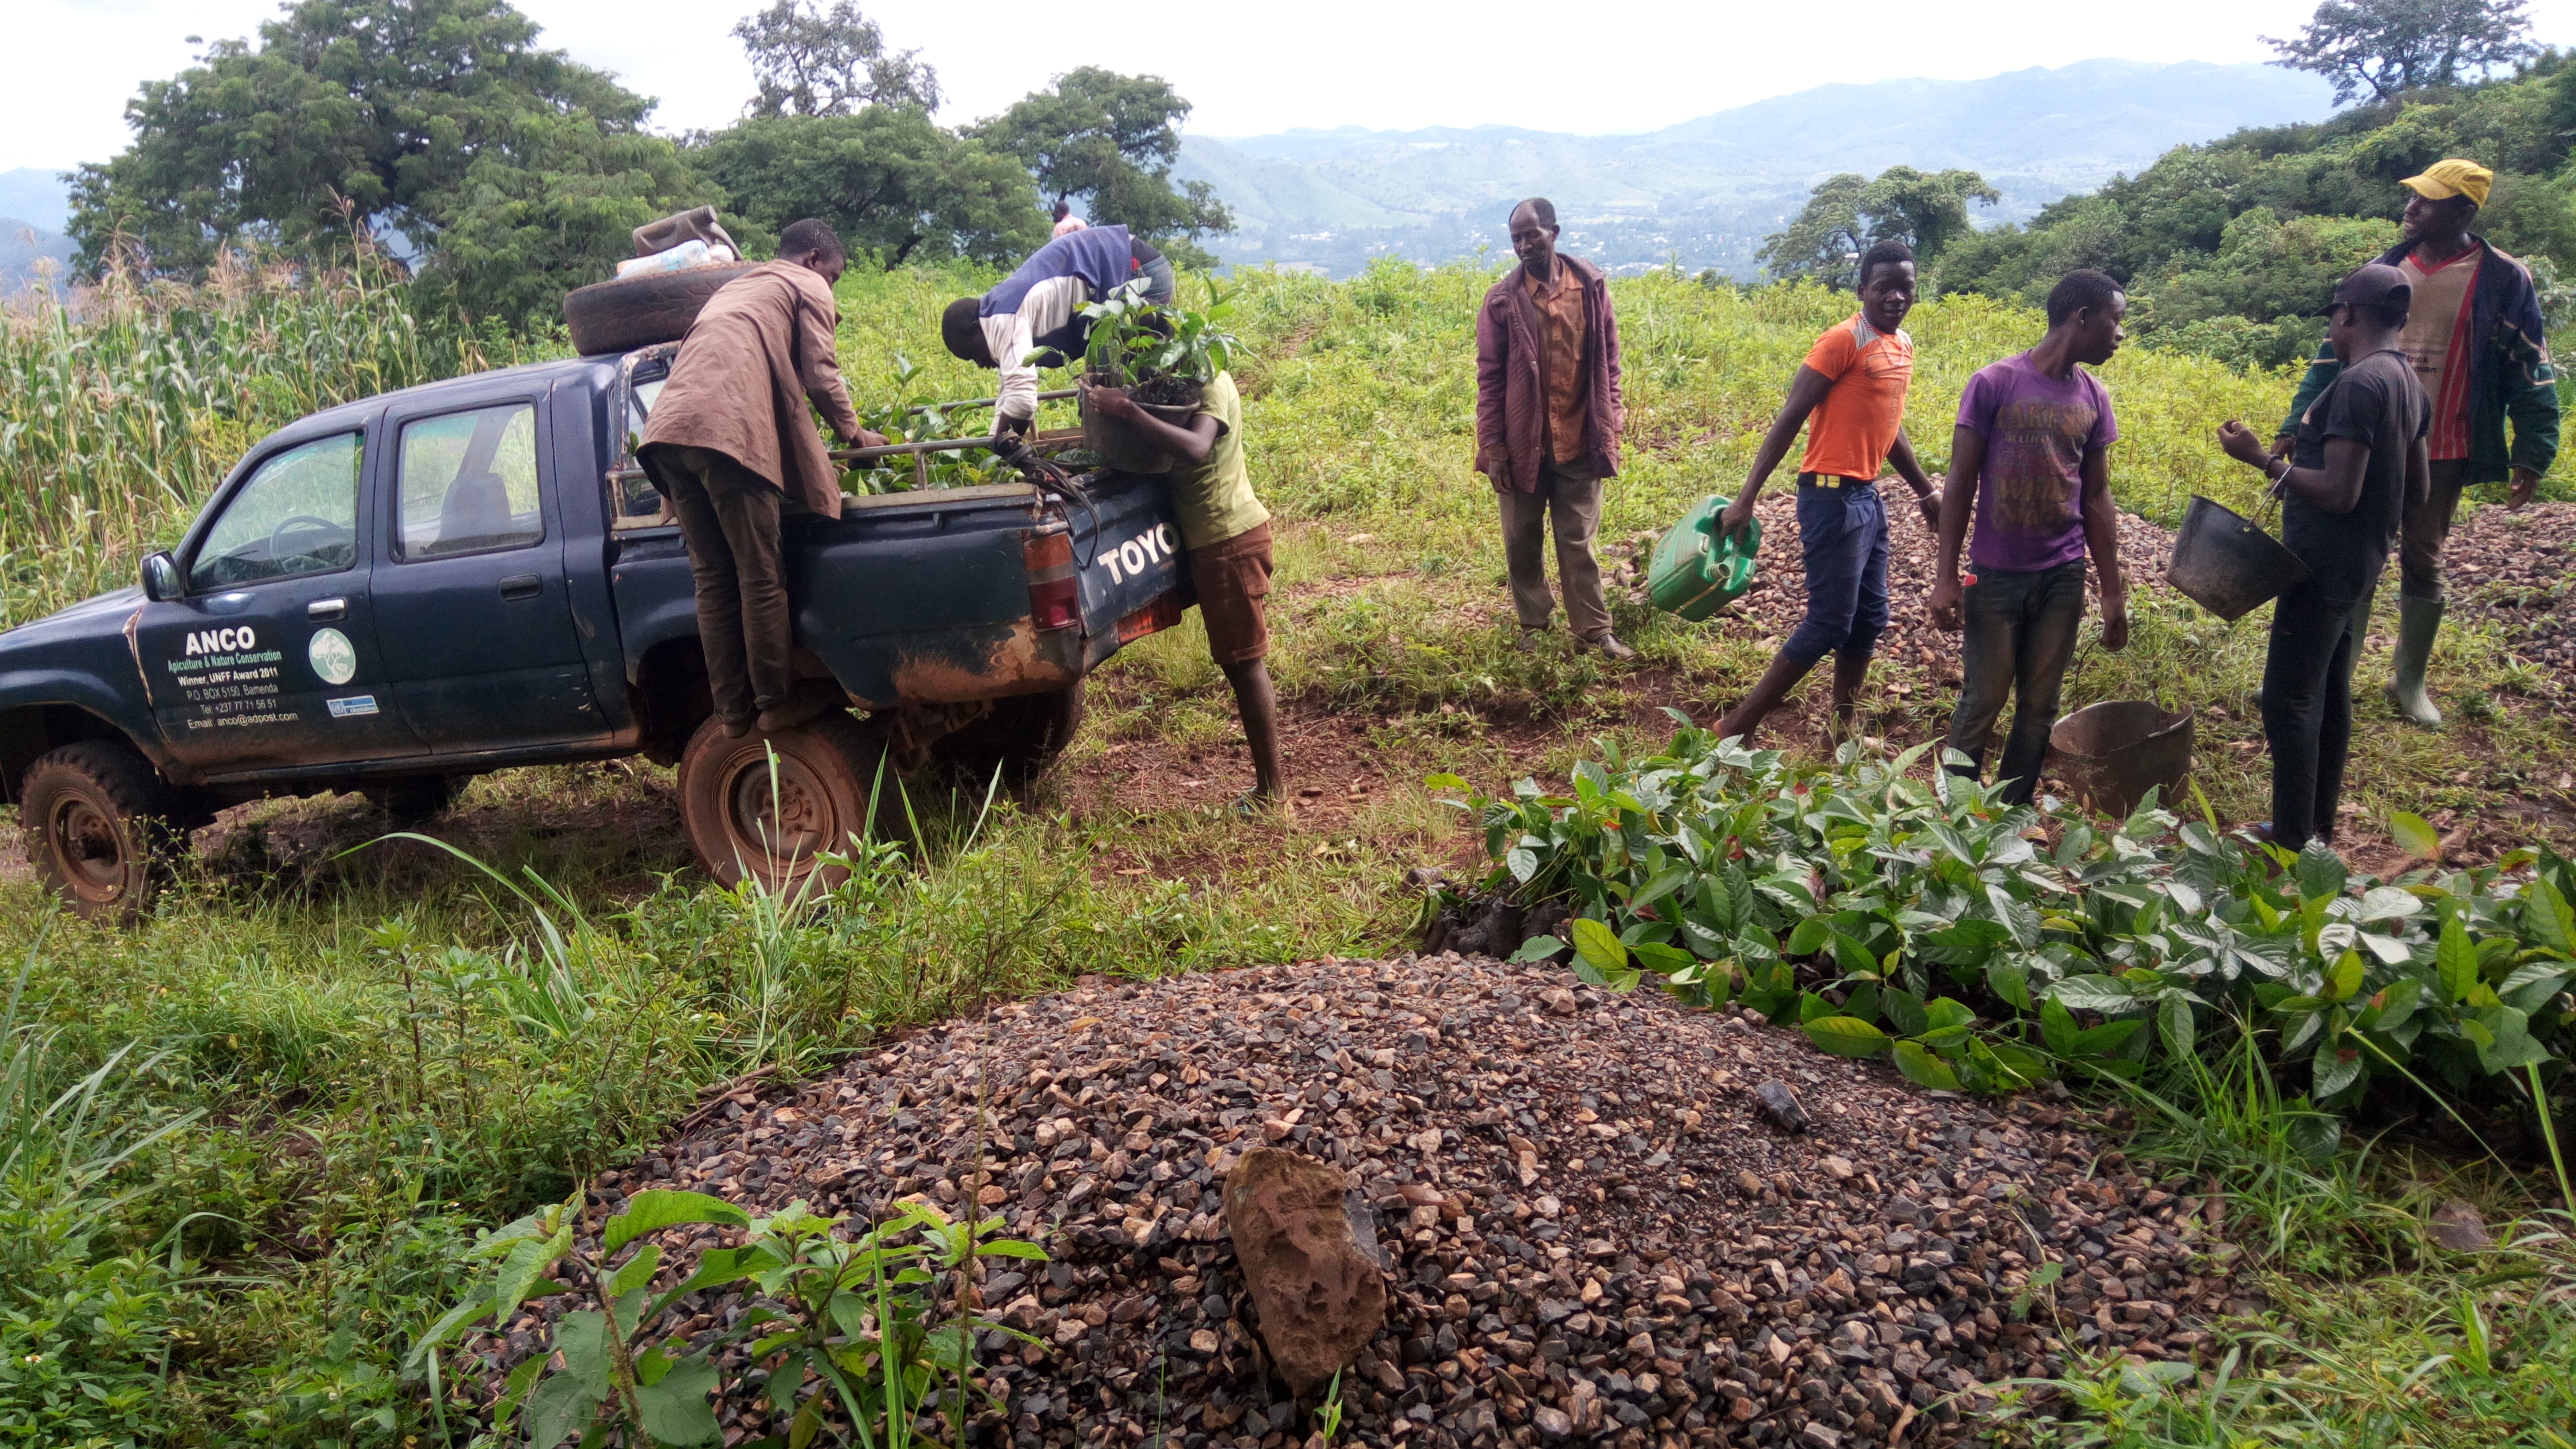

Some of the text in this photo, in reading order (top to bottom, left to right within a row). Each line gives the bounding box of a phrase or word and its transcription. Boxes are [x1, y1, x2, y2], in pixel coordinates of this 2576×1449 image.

[186, 626, 255, 655] ANCO
[168, 649, 282, 674] Apiculture & Nature Conservation
[177, 666, 278, 686] Winner, UNFF Award 2011
[203, 688, 221, 700] BOX
[243, 683, 279, 695] Bamenda
[215, 702, 231, 713] +237
[234, 701, 243, 710] 77
[245, 700, 254, 710] 71
[256, 699, 266, 709] 56
[267, 699, 276, 709] 51
[217, 712, 299, 726] anco@adpost.com
